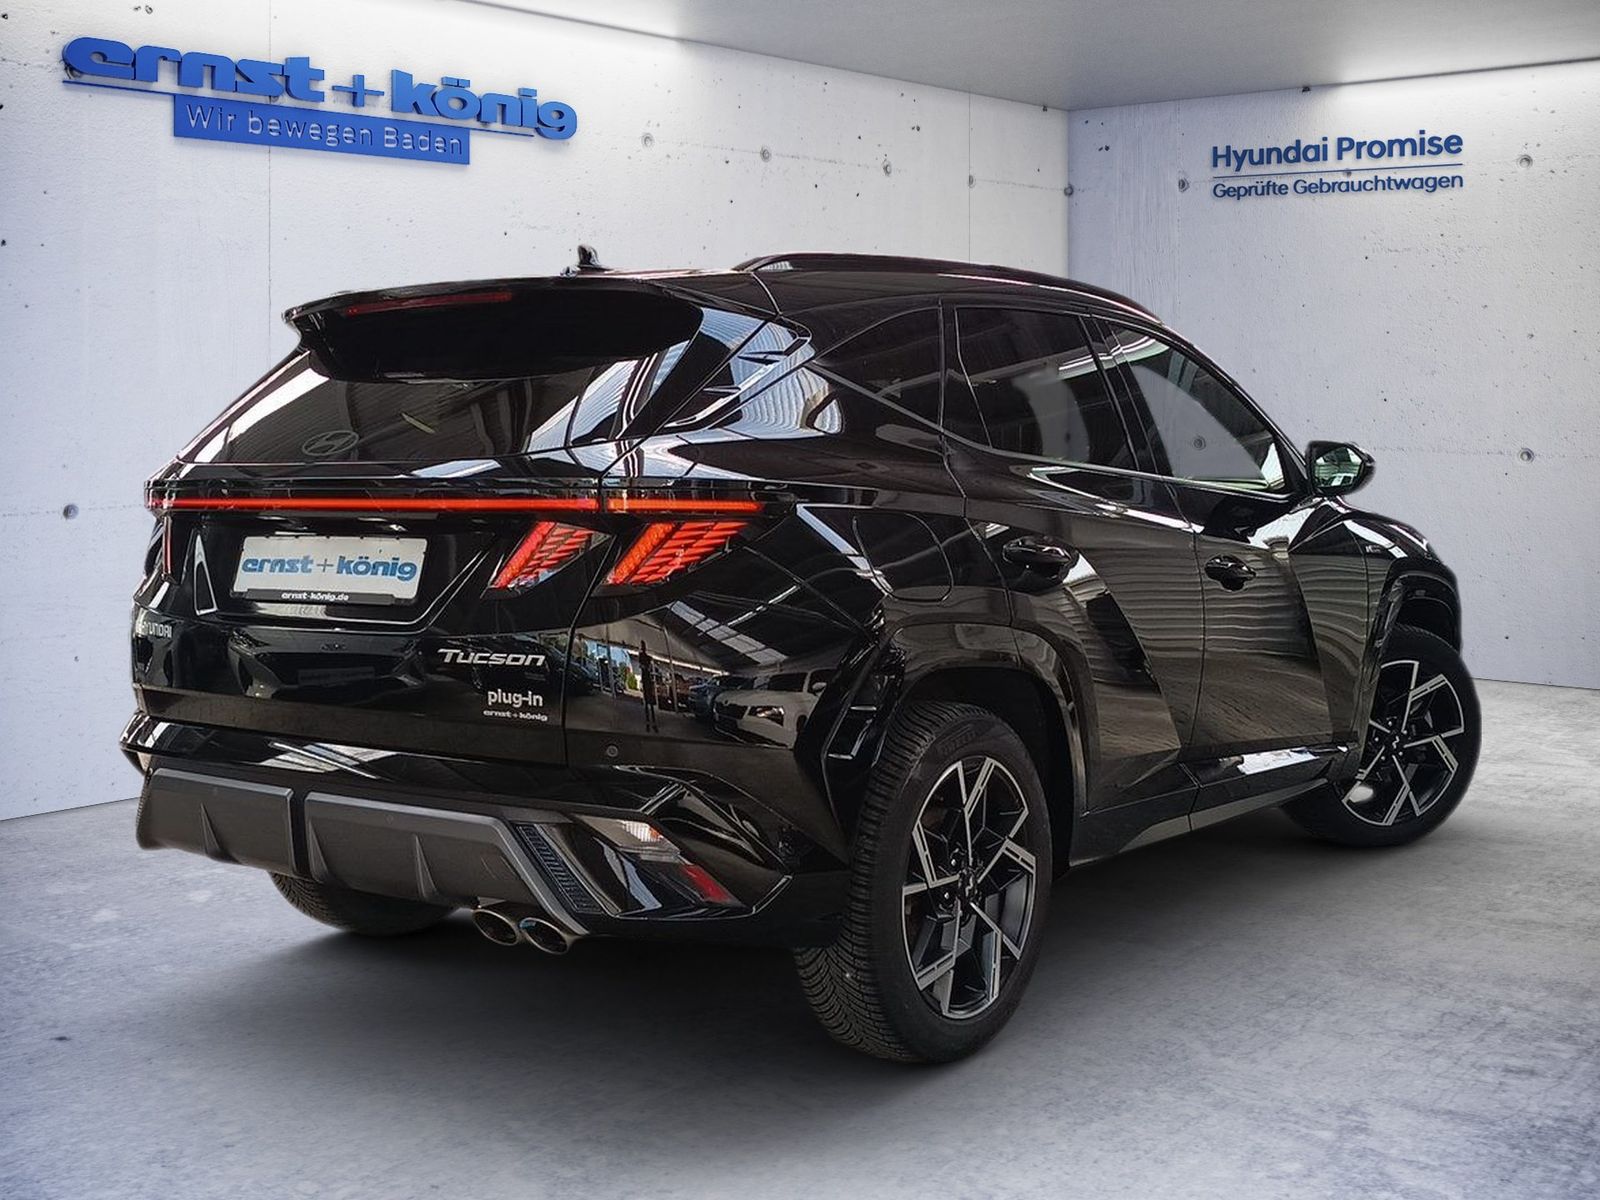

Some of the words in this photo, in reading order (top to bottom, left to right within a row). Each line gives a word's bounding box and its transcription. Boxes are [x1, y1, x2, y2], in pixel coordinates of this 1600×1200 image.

[62, 37, 325, 102] ernst
[391, 69, 577, 140] könig
[186, 104, 235, 131] Wir
[248, 115, 374, 146] bewegen
[384, 127, 464, 156] Baden
[1212, 136, 1328, 172] Hyundai
[1336, 129, 1463, 160] Promise
[1213, 181, 1289, 200] Geprüfte
[1293, 174, 1464, 194] Gebrauchtwagen
[241, 555, 314, 574] ernst
[336, 555, 417, 582] könig
[487, 688, 543, 708] plug-in
[483, 709, 511, 718] ernst
[519, 712, 548, 722] könig
